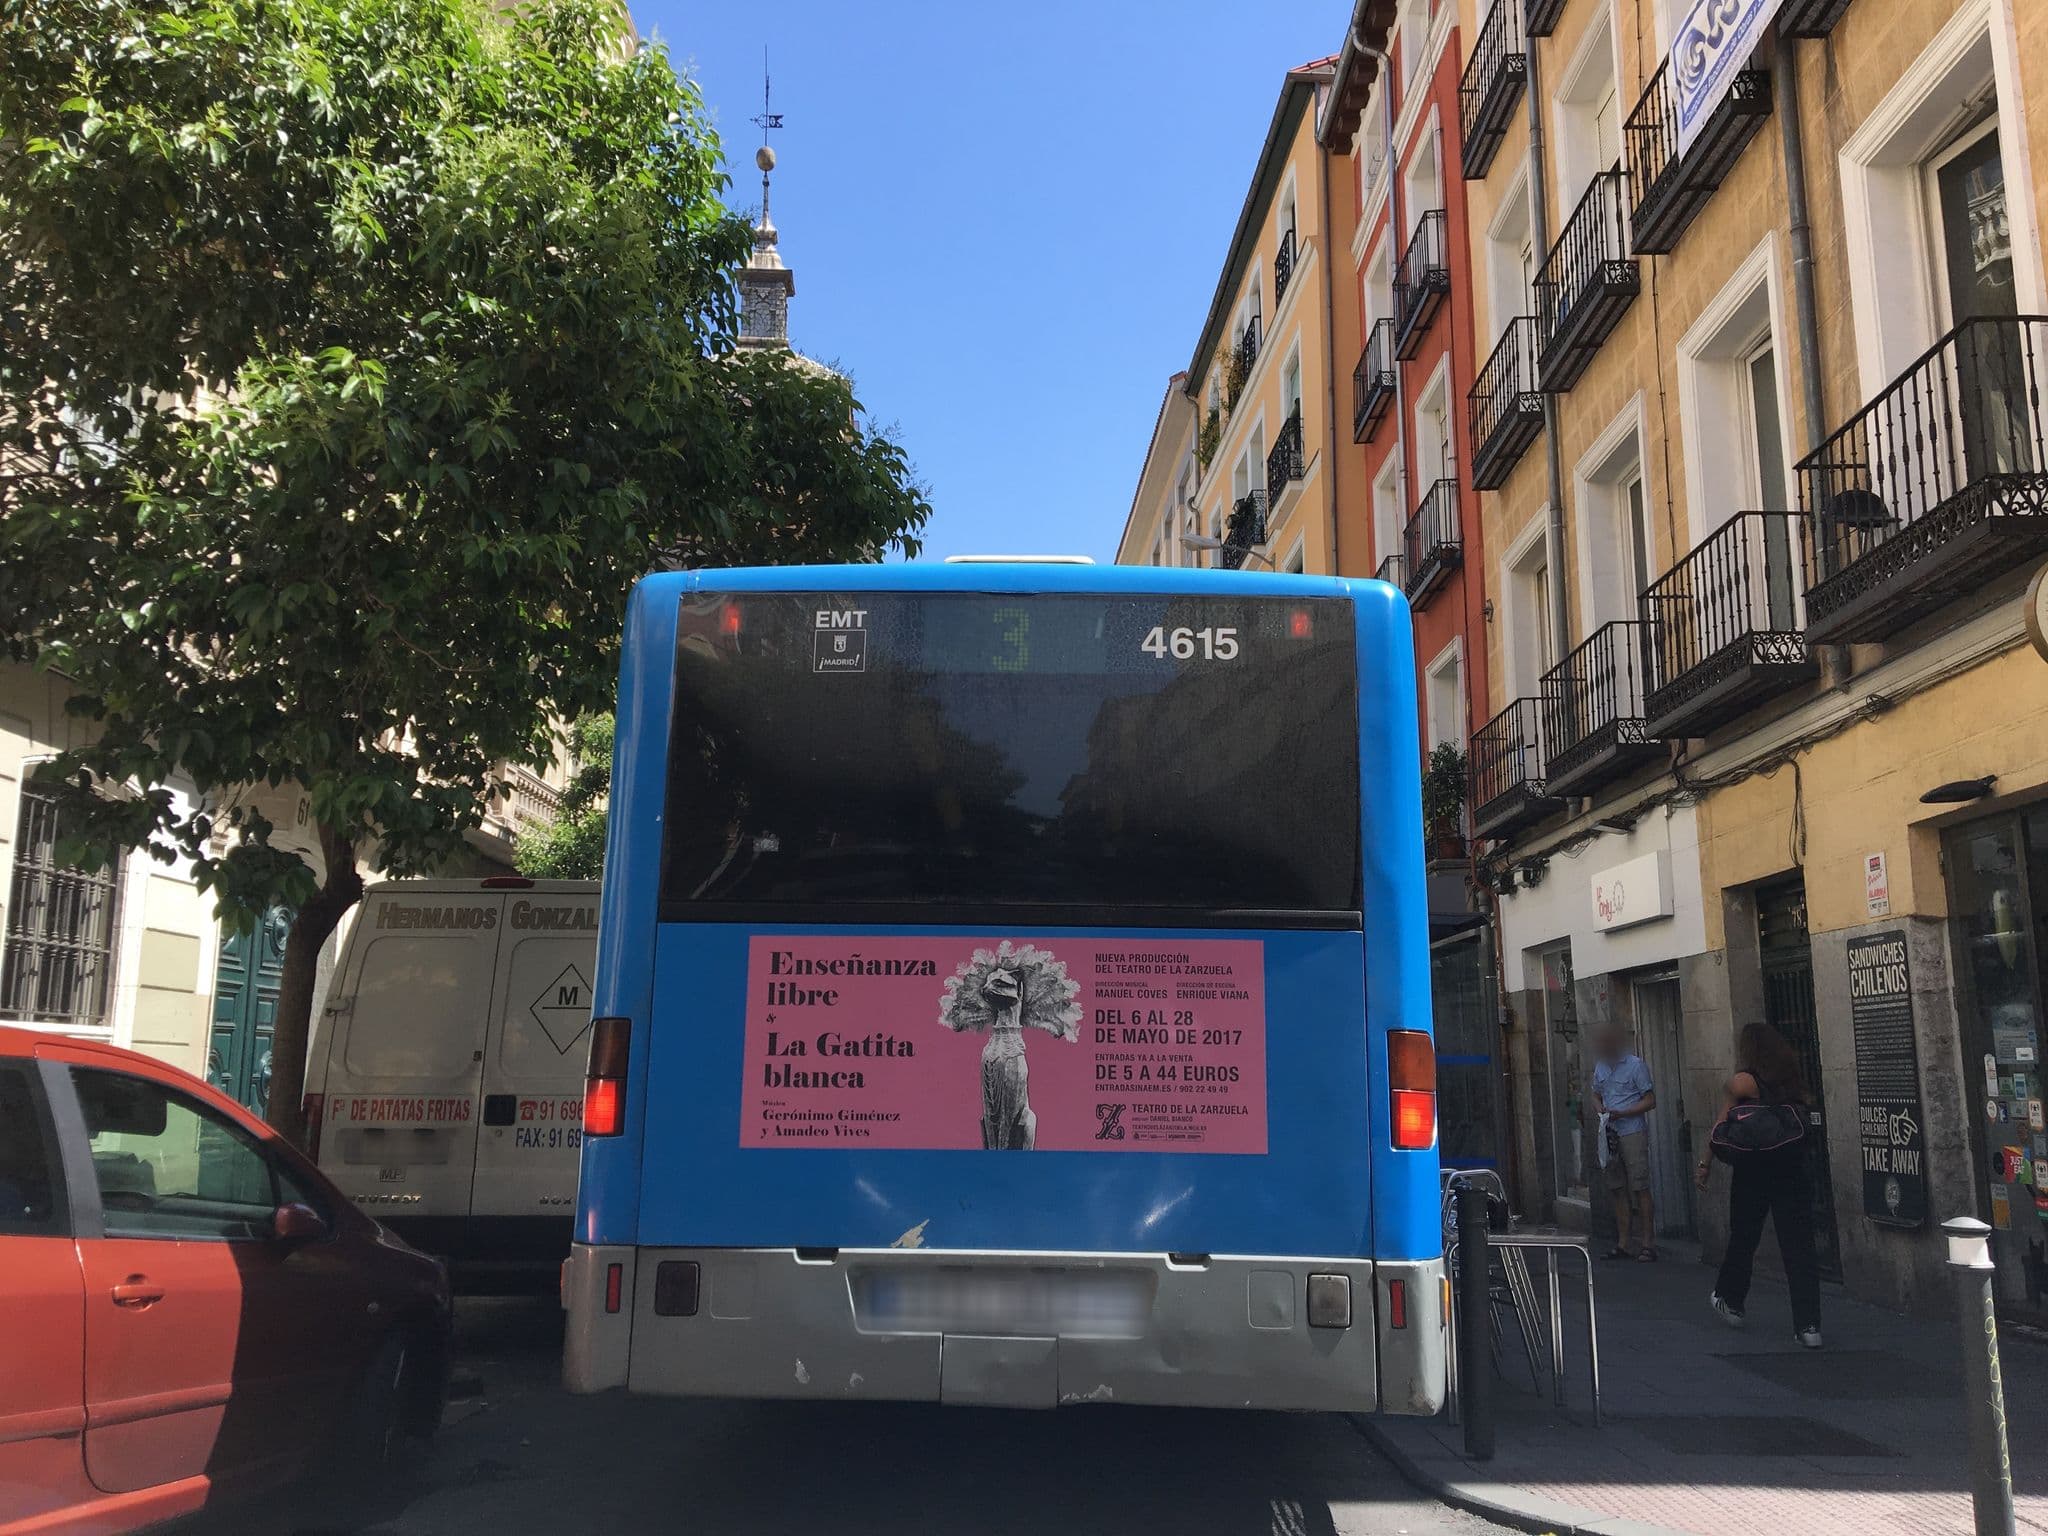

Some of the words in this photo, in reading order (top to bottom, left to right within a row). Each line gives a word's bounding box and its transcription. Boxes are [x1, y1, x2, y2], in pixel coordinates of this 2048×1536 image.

[815, 610, 868, 628] EMT
[993, 607, 1030, 671] 3
[1140, 627, 1239, 660] 4615
[818, 654, 860, 670] ¡MADRID!
[297, 797, 311, 827] 61
[375, 901, 498, 930] HERMANOS
[769, 951, 937, 976] Enseñanza
[1095, 953, 1125, 963] NUEVA
[1128, 953, 1190, 964] PRODUCCIÓN
[1848, 941, 1905, 970] SANDWICHES
[1095, 964, 1112, 974] DEL
[1116, 965, 1151, 974] TEATRO
[1154, 966, 1167, 974] DE
[1169, 966, 1182, 974] LA
[1184, 966, 1233, 975] ZARZUELA
[1850, 964, 1908, 998] CHILENOS
[558, 986, 579, 1005] M
[767, 982, 839, 1006] libre
[1095, 989, 1134, 999] MANUEL
[1137, 989, 1168, 999] COVES
[1176, 990, 1217, 1000] ENRIQUE
[1220, 991, 1249, 1000] VIANA
[766, 1013, 777, 1024] &
[1095, 1009, 1126, 1025] DEL
[1131, 1010, 1142, 1025] 6
[1147, 1010, 1168, 1025] AL
[1173, 1011, 1194, 1026] 28
[765, 1032, 807, 1057] La
[816, 1032, 915, 1057] Gatita
[1095, 1028, 1116, 1044] DE
[1122, 1028, 1169, 1044] MAYO
[1175, 1029, 1197, 1044] DE
[1202, 1029, 1242, 1045] 2017
[1095, 1053, 1135, 1061] ENTRADAS
[1168, 1054, 1193, 1062] VENTA
[763, 1063, 866, 1089] blanca
[1095, 1064, 1117, 1080] DE
[1123, 1065, 1133, 1080] 5
[1139, 1066, 1151, 1080] A
[1156, 1066, 1177, 1080] 44
[1183, 1066, 1240, 1082] EUROS
[1095, 1084, 1172, 1092] ENTRADASINAEM.ES
[1179, 1085, 1194, 1093] 902
[1195, 1085, 1206, 1093] 22
[1206, 1085, 1217, 1093] 49
[1218, 1085, 1229, 1093] 49
[350, 1099, 367, 1121] DE
[369, 1099, 424, 1121] PATATAS
[426, 1099, 470, 1121] FRITAS
[539, 1100, 556, 1121] 91
[762, 1108, 834, 1121] Gerónimo
[837, 1108, 901, 1121] Giménez
[1131, 1103, 1168, 1114] TEATRO
[1170, 1104, 1183, 1114] DE
[1185, 1104, 1198, 1114] LA
[1200, 1104, 1249, 1115] ZARZUELA
[1860, 1106, 1888, 1123] DULCES
[515, 1127, 545, 1148] FAX:
[548, 1128, 563, 1148] 91
[760, 1127, 768, 1140] y
[772, 1125, 829, 1137] Amadeo
[833, 1125, 870, 1137] Vives
[1861, 1123, 1889, 1137] CHILENOS
[1862, 1147, 1889, 1173] TAKE
[1892, 1148, 1920, 1176] AWAY
[2009, 1156, 2024, 1167] JUST
